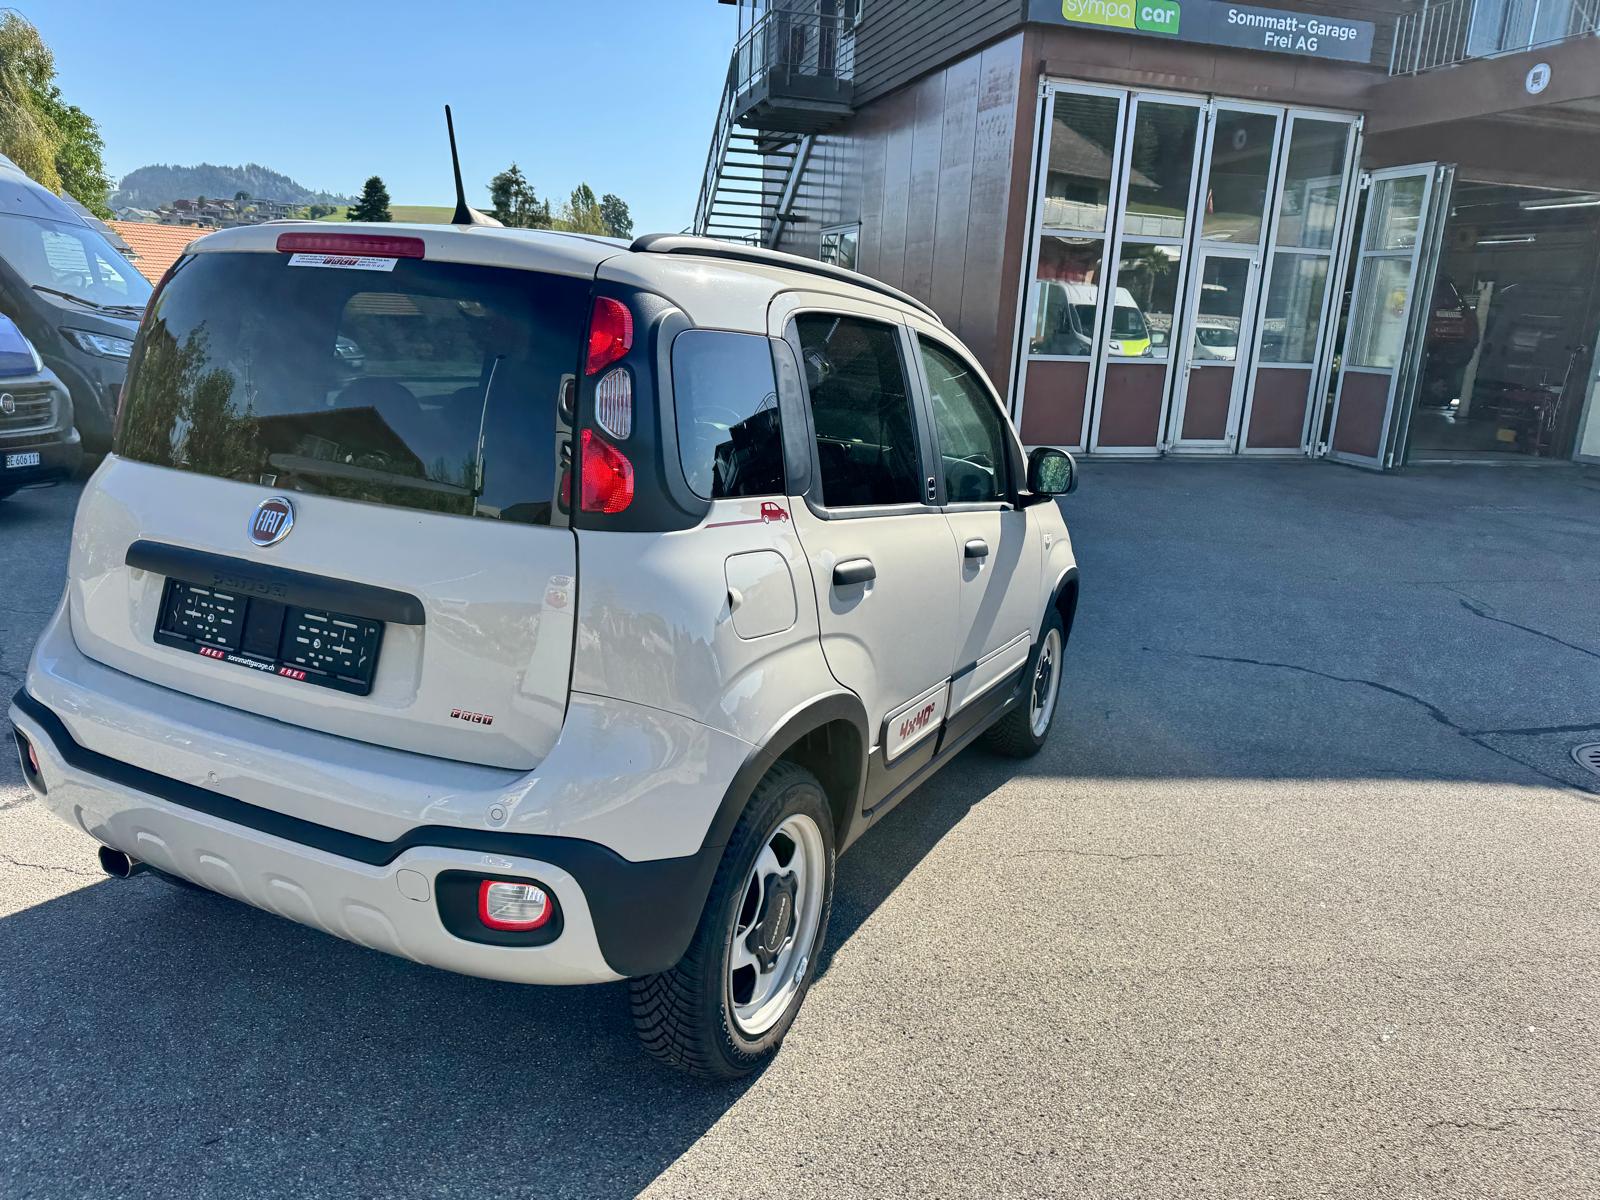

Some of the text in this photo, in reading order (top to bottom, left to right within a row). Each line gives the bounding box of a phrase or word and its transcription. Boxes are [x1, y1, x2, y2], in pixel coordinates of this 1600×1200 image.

[1066, 0, 1175, 24] sympa car
[1227, 9, 1357, 40] Sonnmatt-Garage
[1264, 32, 1318, 51] Frei AG
[256, 509, 286, 534] FIAT
